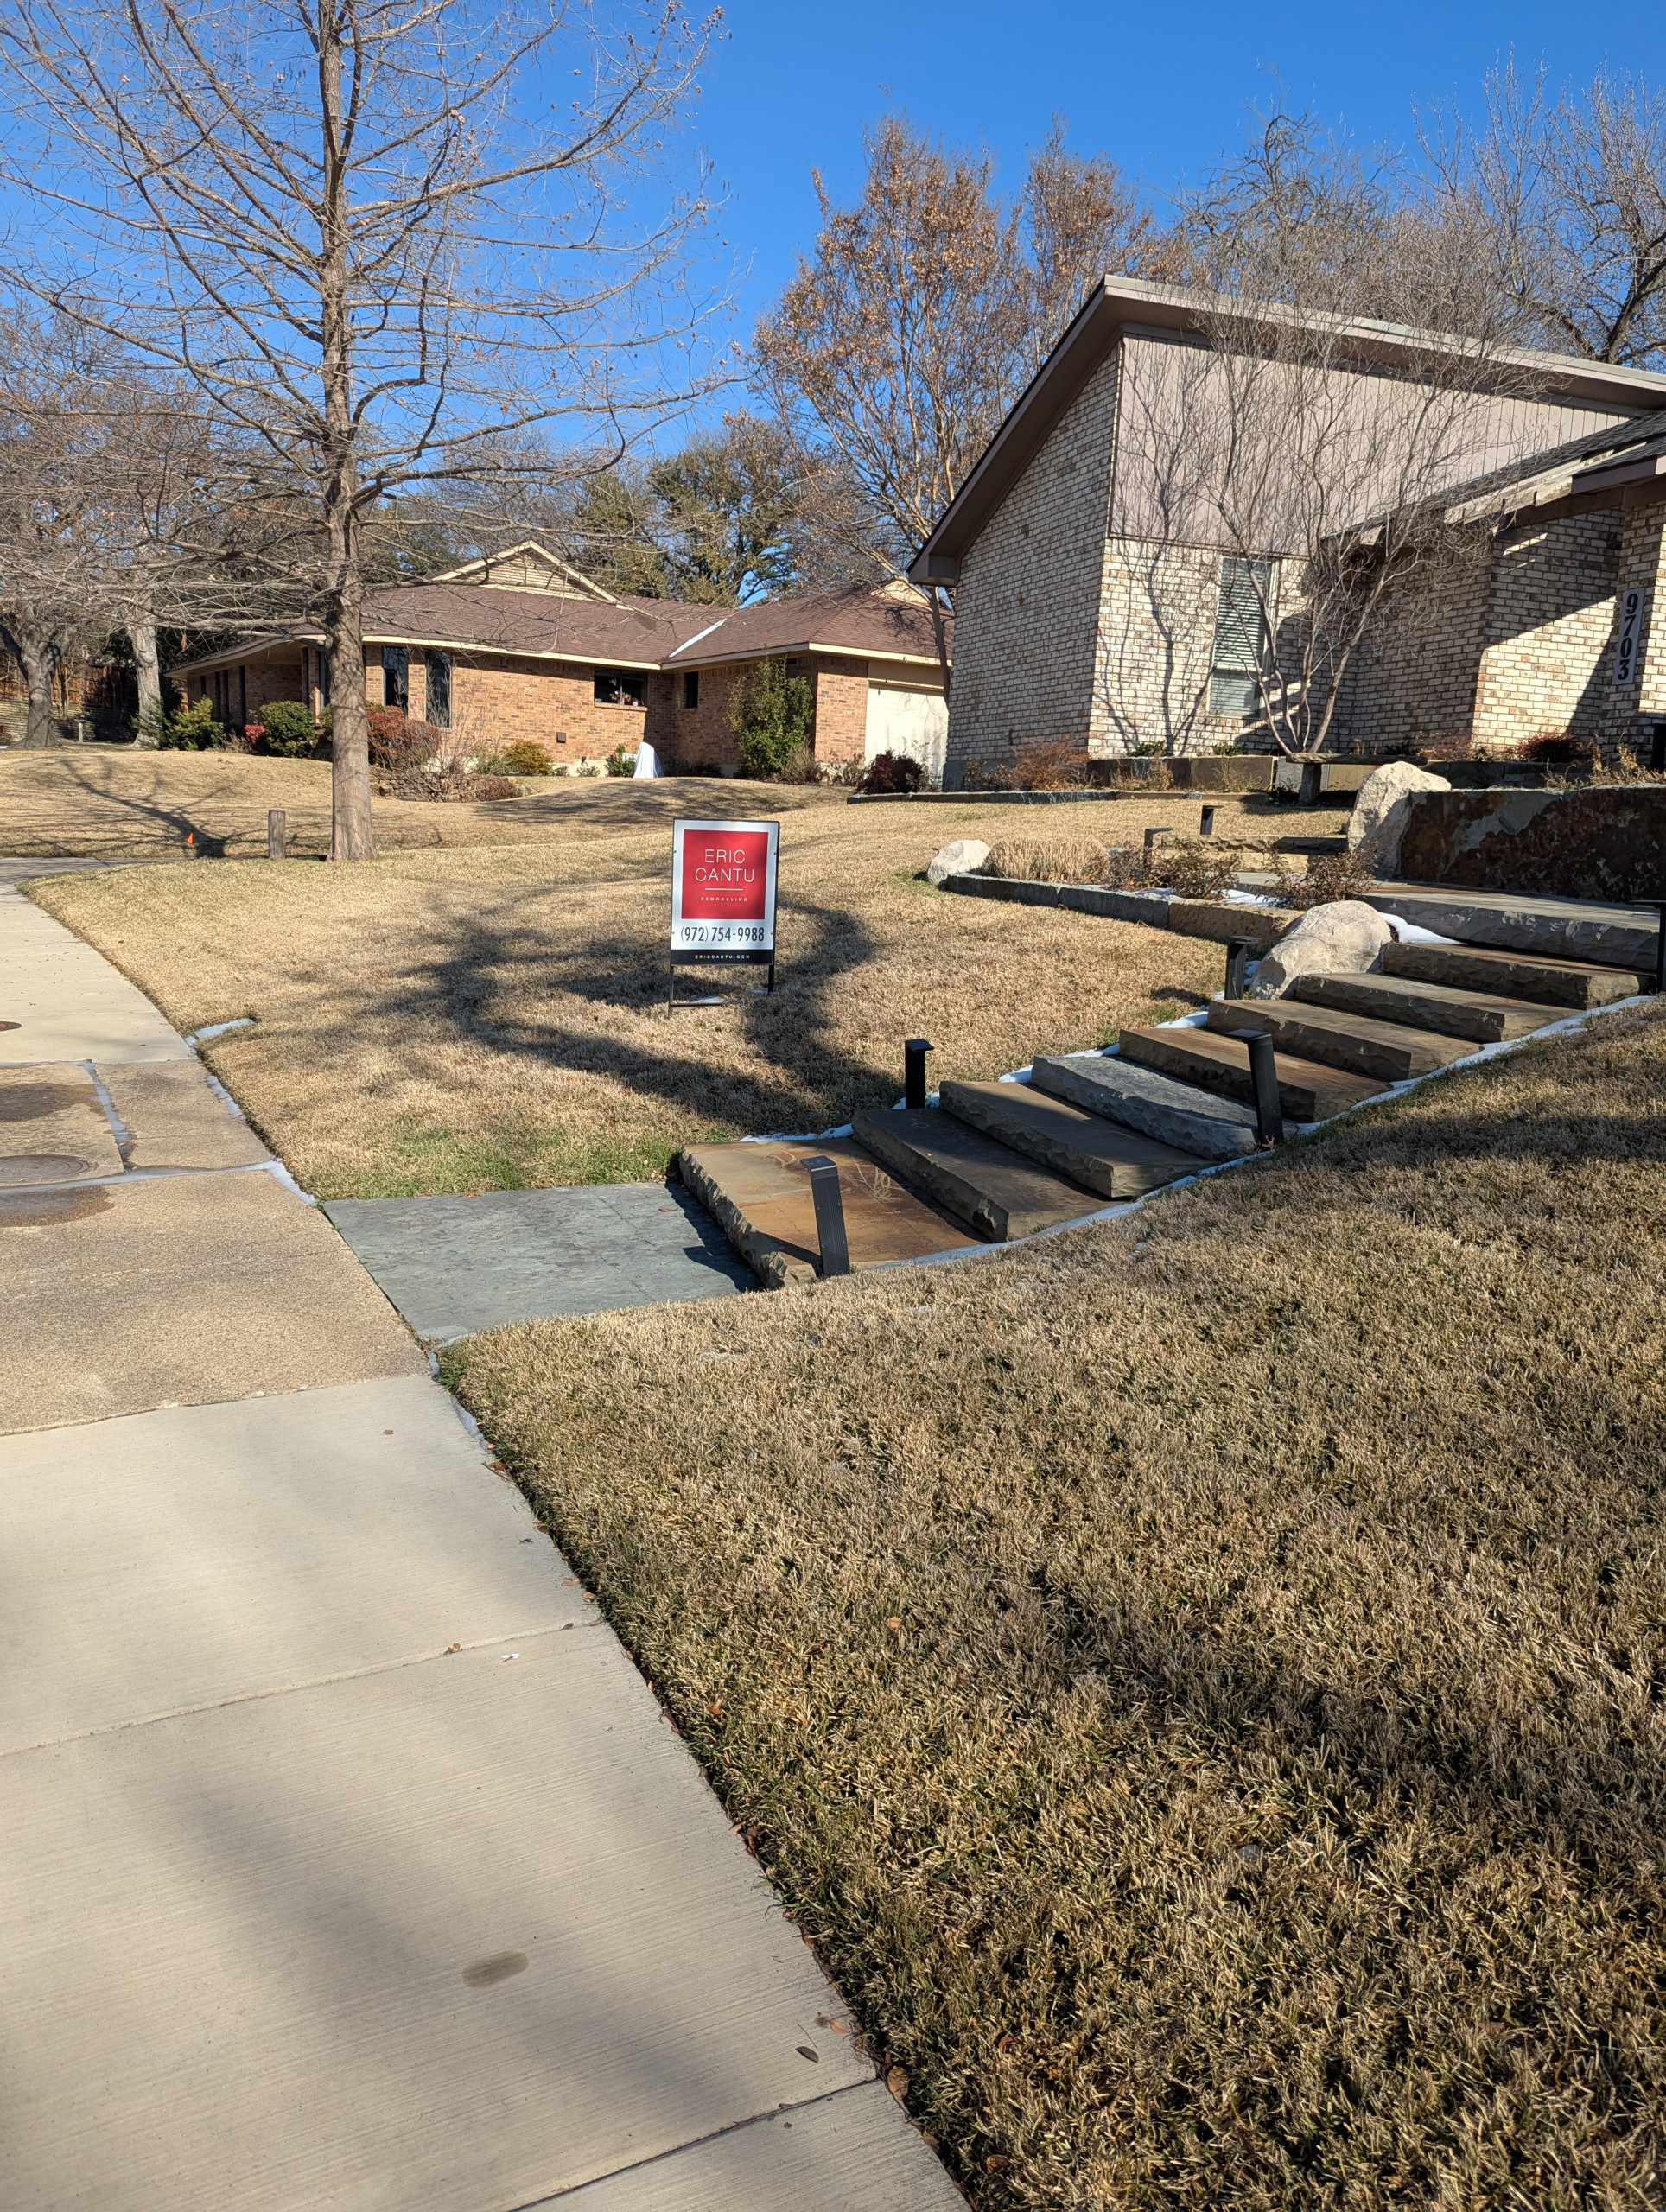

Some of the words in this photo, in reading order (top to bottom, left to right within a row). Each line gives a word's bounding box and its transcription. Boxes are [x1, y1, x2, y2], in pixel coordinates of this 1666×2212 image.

[1617, 593, 1638, 681] 9703
[704, 849, 745, 863] ERIC
[695, 868, 754, 882] CANTU
[681, 926, 709, 942] (972)
[711, 927, 764, 942] 754-9988
